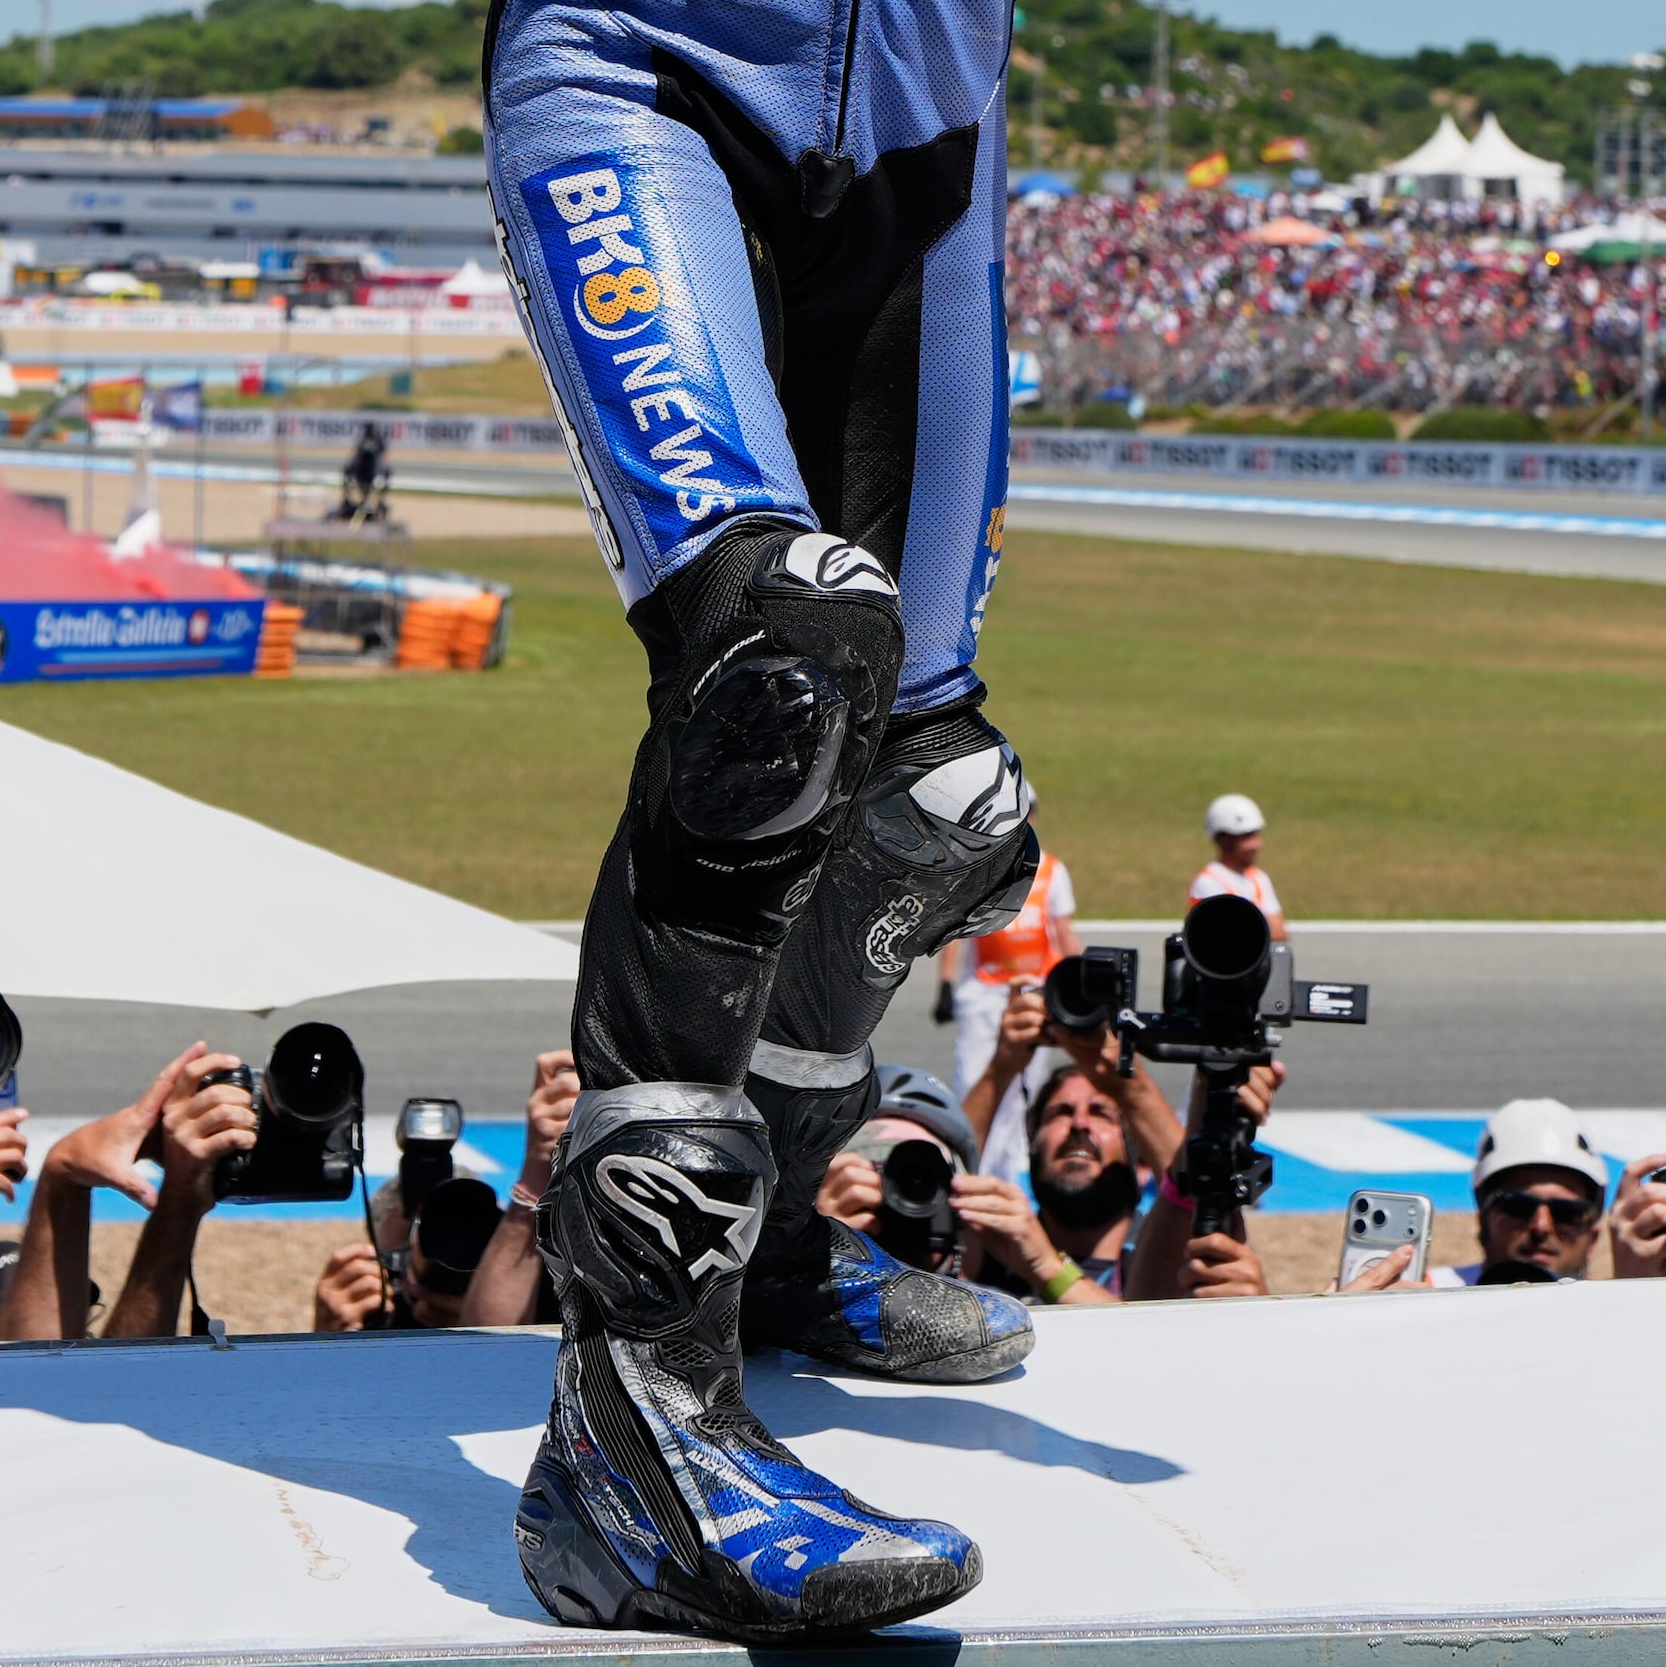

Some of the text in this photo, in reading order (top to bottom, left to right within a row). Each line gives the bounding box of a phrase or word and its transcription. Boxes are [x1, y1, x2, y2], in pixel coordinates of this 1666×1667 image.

[546, 167, 662, 326] BK8
[613, 341, 736, 524] NEWS
[692, 660, 720, 697] one
